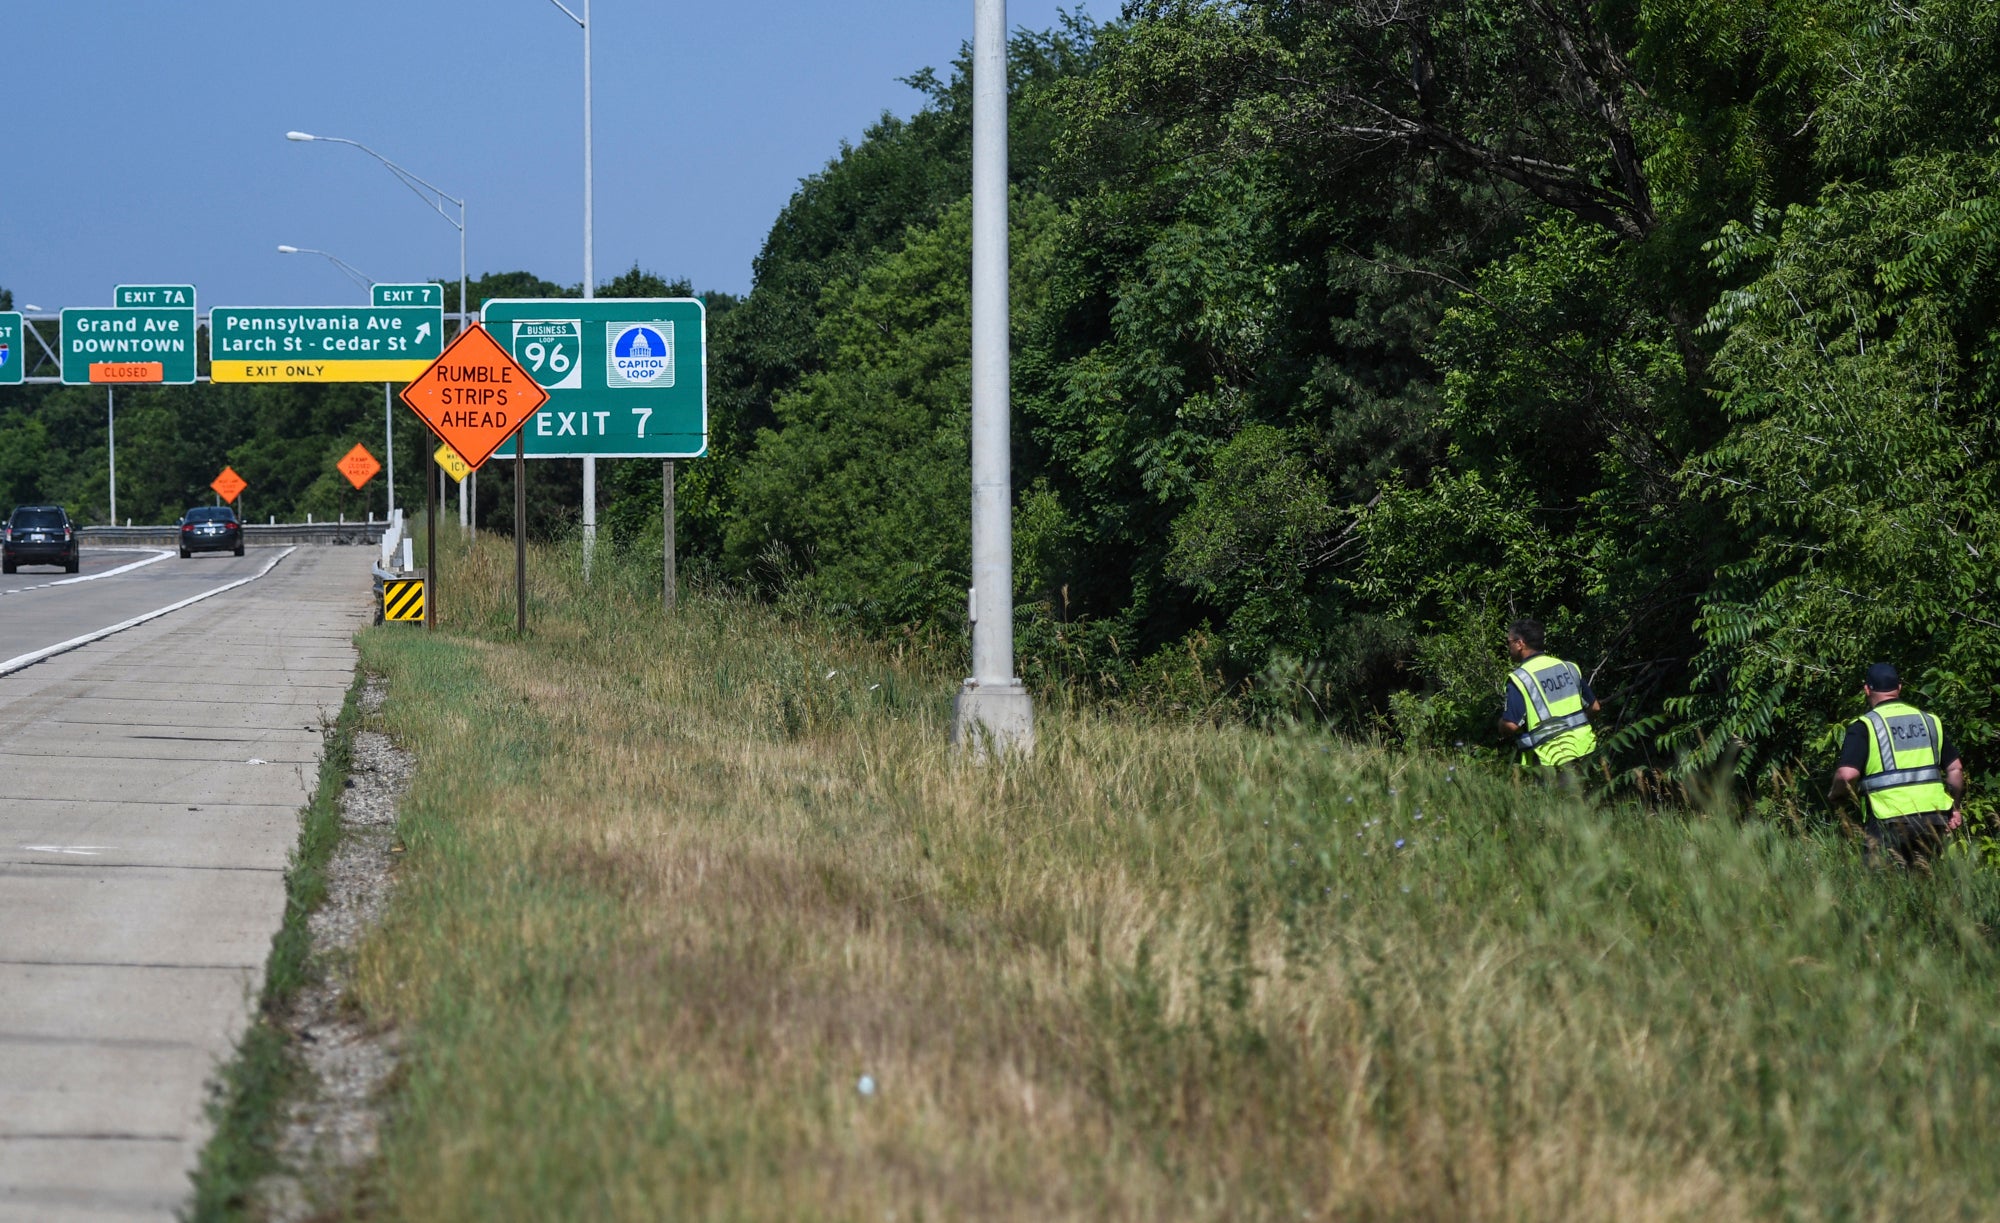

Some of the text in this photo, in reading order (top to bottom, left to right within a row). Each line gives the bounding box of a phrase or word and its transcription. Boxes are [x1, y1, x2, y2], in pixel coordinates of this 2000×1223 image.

[125, 291, 185, 303] EXIT 7A
[384, 290, 430, 302] EXIT 7
[77, 317, 179, 332] Grand Ave
[227, 316, 402, 334] Pennsylvania Ave
[527, 325, 567, 335] BUSINESS
[73, 339, 185, 352] DOWNTOWN
[223, 337, 276, 352] Larch
[283, 337, 302, 351] St
[323, 336, 380, 351] Cedar
[388, 336, 407, 351] St
[525, 342, 570, 372] 96
[618, 360, 664, 369] CAPITOL
[104, 367, 148, 378] CLOSED
[246, 366, 324, 376] EXIT ONLY
[437, 365, 512, 384] RUMBLE
[627, 370, 655, 379] LOOP
[442, 388, 508, 406] STRIPS
[440, 411, 507, 428] AHEAD
[537, 408, 653, 438] EXIT 7
[451, 462, 465, 471] ICY
[1541, 672, 1573, 693] POLICE
[1891, 723, 1927, 740] POLICE
